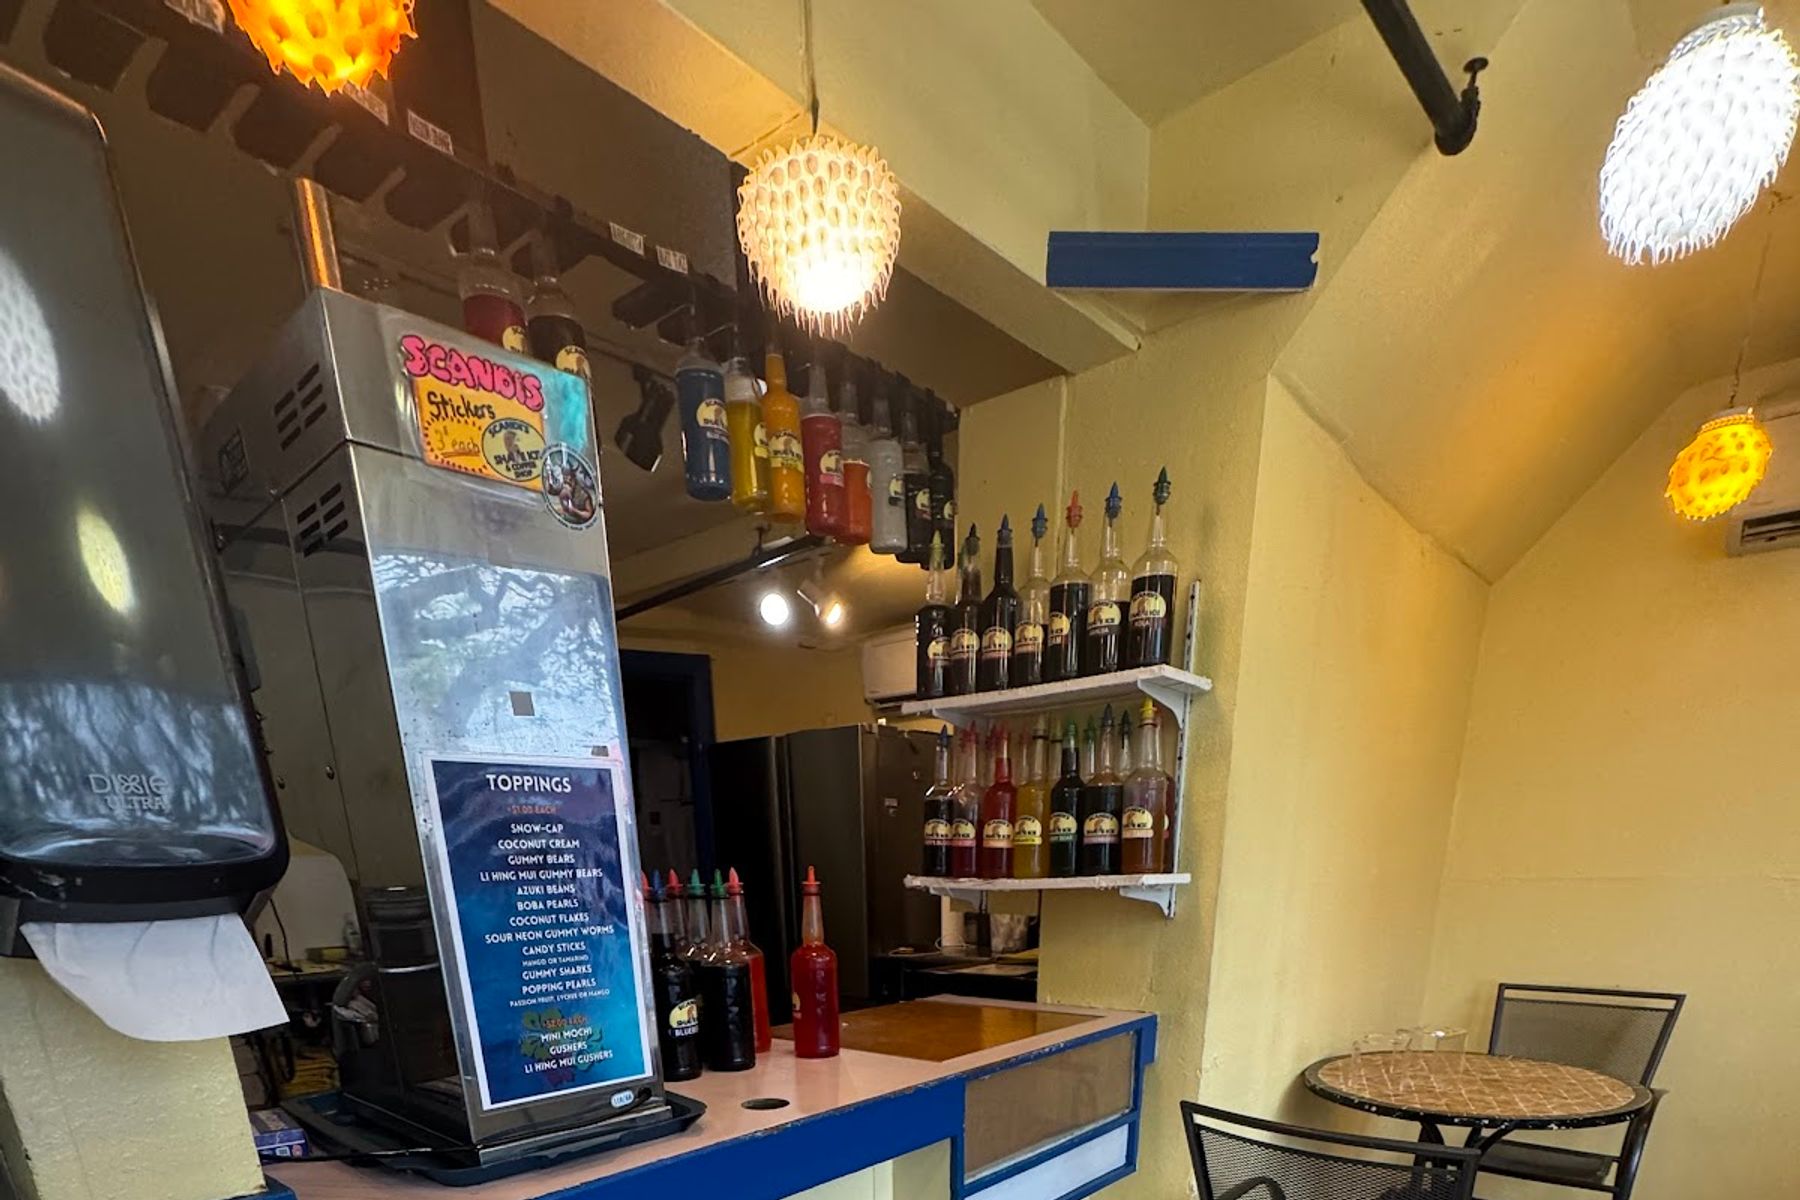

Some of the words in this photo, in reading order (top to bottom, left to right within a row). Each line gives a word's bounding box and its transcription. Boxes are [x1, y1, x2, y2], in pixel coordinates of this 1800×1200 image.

[427, 391, 496, 420] Stickers
[486, 774, 572, 793] TOPPINGS
[104, 796, 168, 810] ULTRA
[510, 823, 564, 834] SNOW-CAP
[497, 839, 546, 850] COCONUT
[548, 839, 580, 849] CREAM
[507, 855, 544, 866] GUMMY
[546, 854, 576, 864] BEARS
[479, 872, 490, 882] LI
[491, 870, 516, 881] HING
[517, 870, 537, 880] MUI
[539, 869, 574, 880] GUMMY
[575, 868, 604, 879] BEARS
[516, 885, 545, 896] AZUKI
[546, 883, 576, 894] BEANS
[516, 901, 544, 911] BOBA
[546, 898, 579, 909] PEARLS
[509, 914, 557, 927] COCONUT
[558, 912, 590, 923] FLAKES
[484, 932, 513, 945] SOUR
[514, 930, 543, 942] NEON
[544, 928, 580, 940] GUMMY
[580, 924, 615, 936] WORMS
[521, 943, 555, 956] CANDY
[556, 941, 586, 952] STICKS
[521, 968, 558, 981] GUMMY
[559, 964, 593, 977] SHARKS
[521, 981, 564, 996] POPPING
[565, 977, 597, 991] PEARLS
[540, 1031, 562, 1043] MINI
[562, 1026, 593, 1039] MOCHI
[549, 1041, 588, 1055] GUSHERS
[524, 1063, 534, 1074] LI
[534, 1059, 558, 1073] HING
[558, 1056, 577, 1068] MUI
[577, 1049, 613, 1064] GUSHERS
